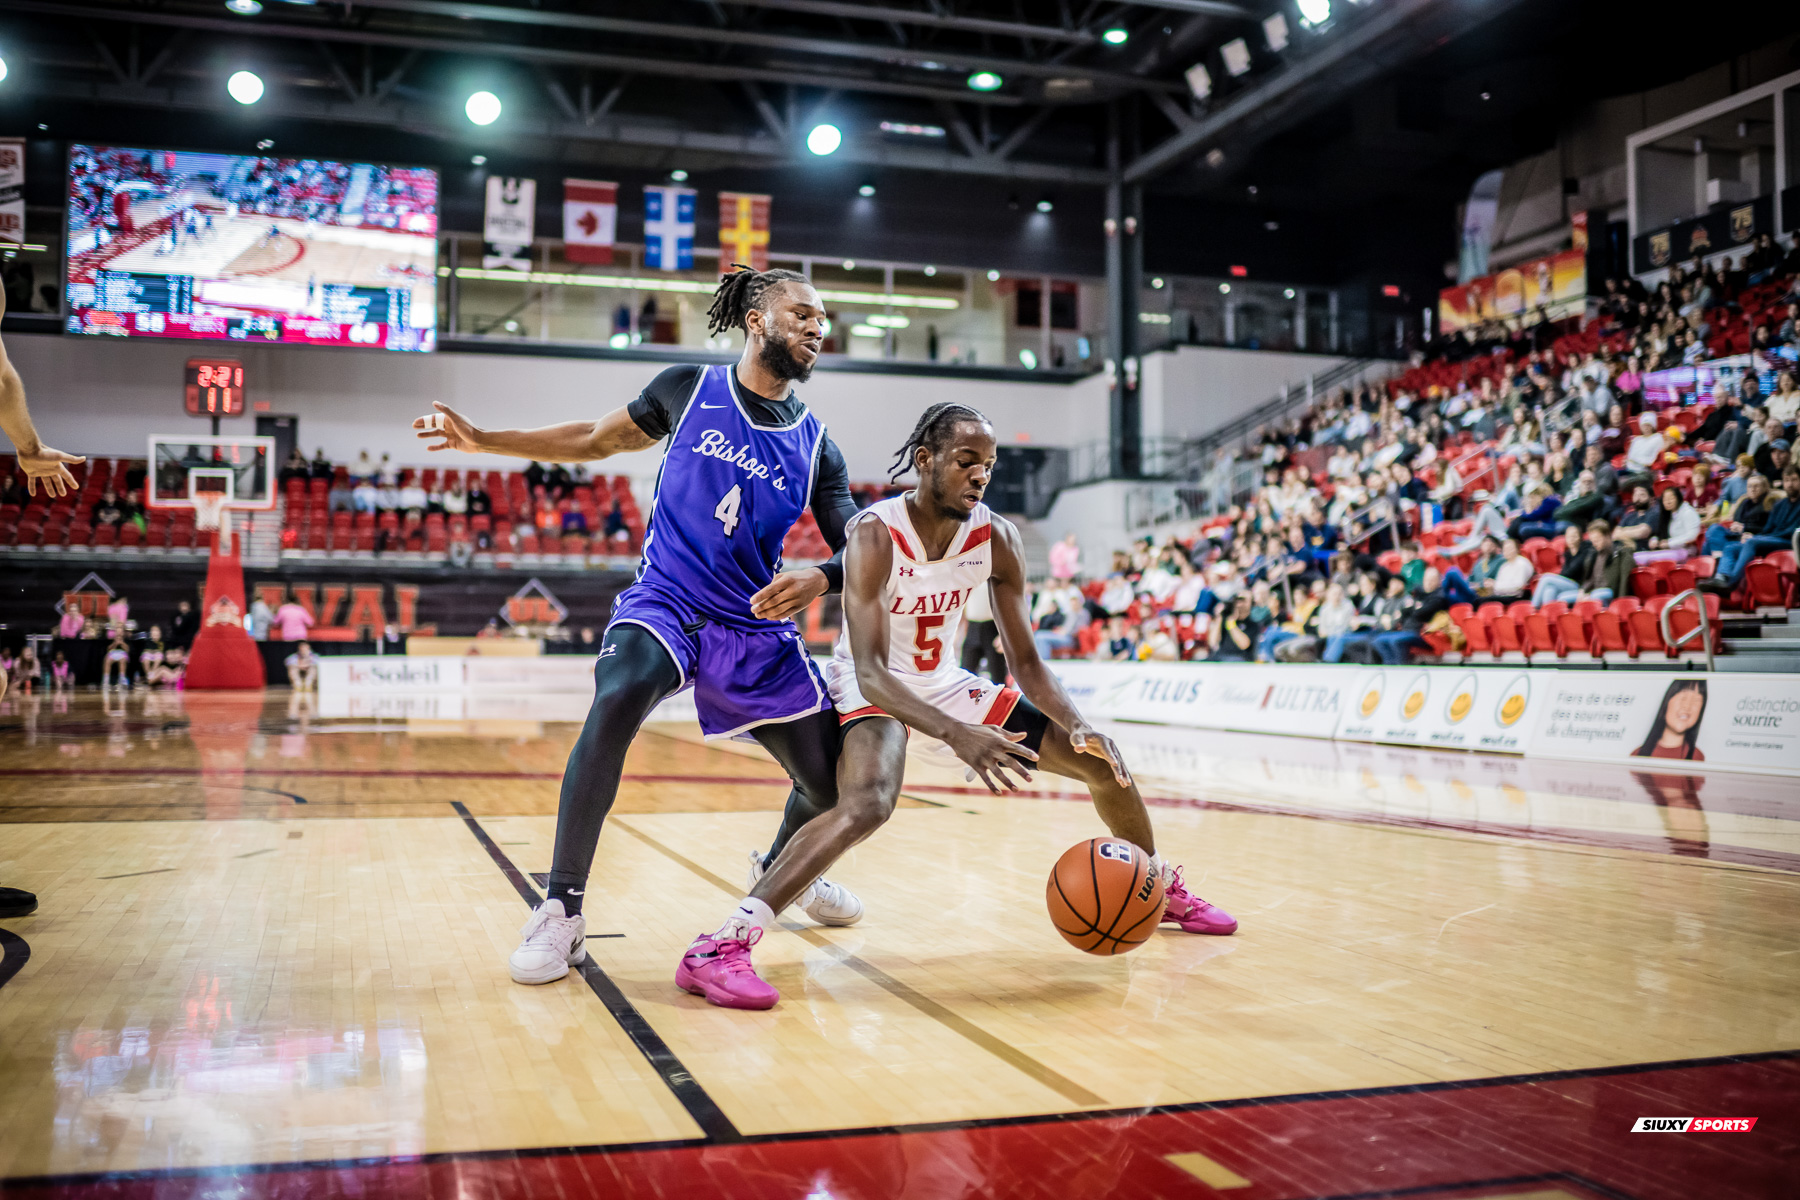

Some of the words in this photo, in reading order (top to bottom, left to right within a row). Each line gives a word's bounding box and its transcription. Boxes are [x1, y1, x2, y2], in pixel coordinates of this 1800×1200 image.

[198, 365, 244, 388] 2:21
[207, 387, 232, 413] 11
[692, 429, 786, 491] Bishop's
[713, 483, 743, 537] 4
[912, 614, 946, 673] 5
[1140, 679, 1202, 703] TELUS
[1275, 685, 1340, 712] ULTRA
[1557, 690, 1583, 703] Fiers
[1586, 692, 1600, 704] de
[1604, 693, 1635, 706] créer
[1551, 708, 1571, 721] des
[1573, 710, 1619, 722] sourires
[1736, 696, 1800, 713] distinctio
[1732, 712, 1782, 728] sourire
[1545, 723, 1558, 737] de
[1560, 723, 1626, 742] champions!
